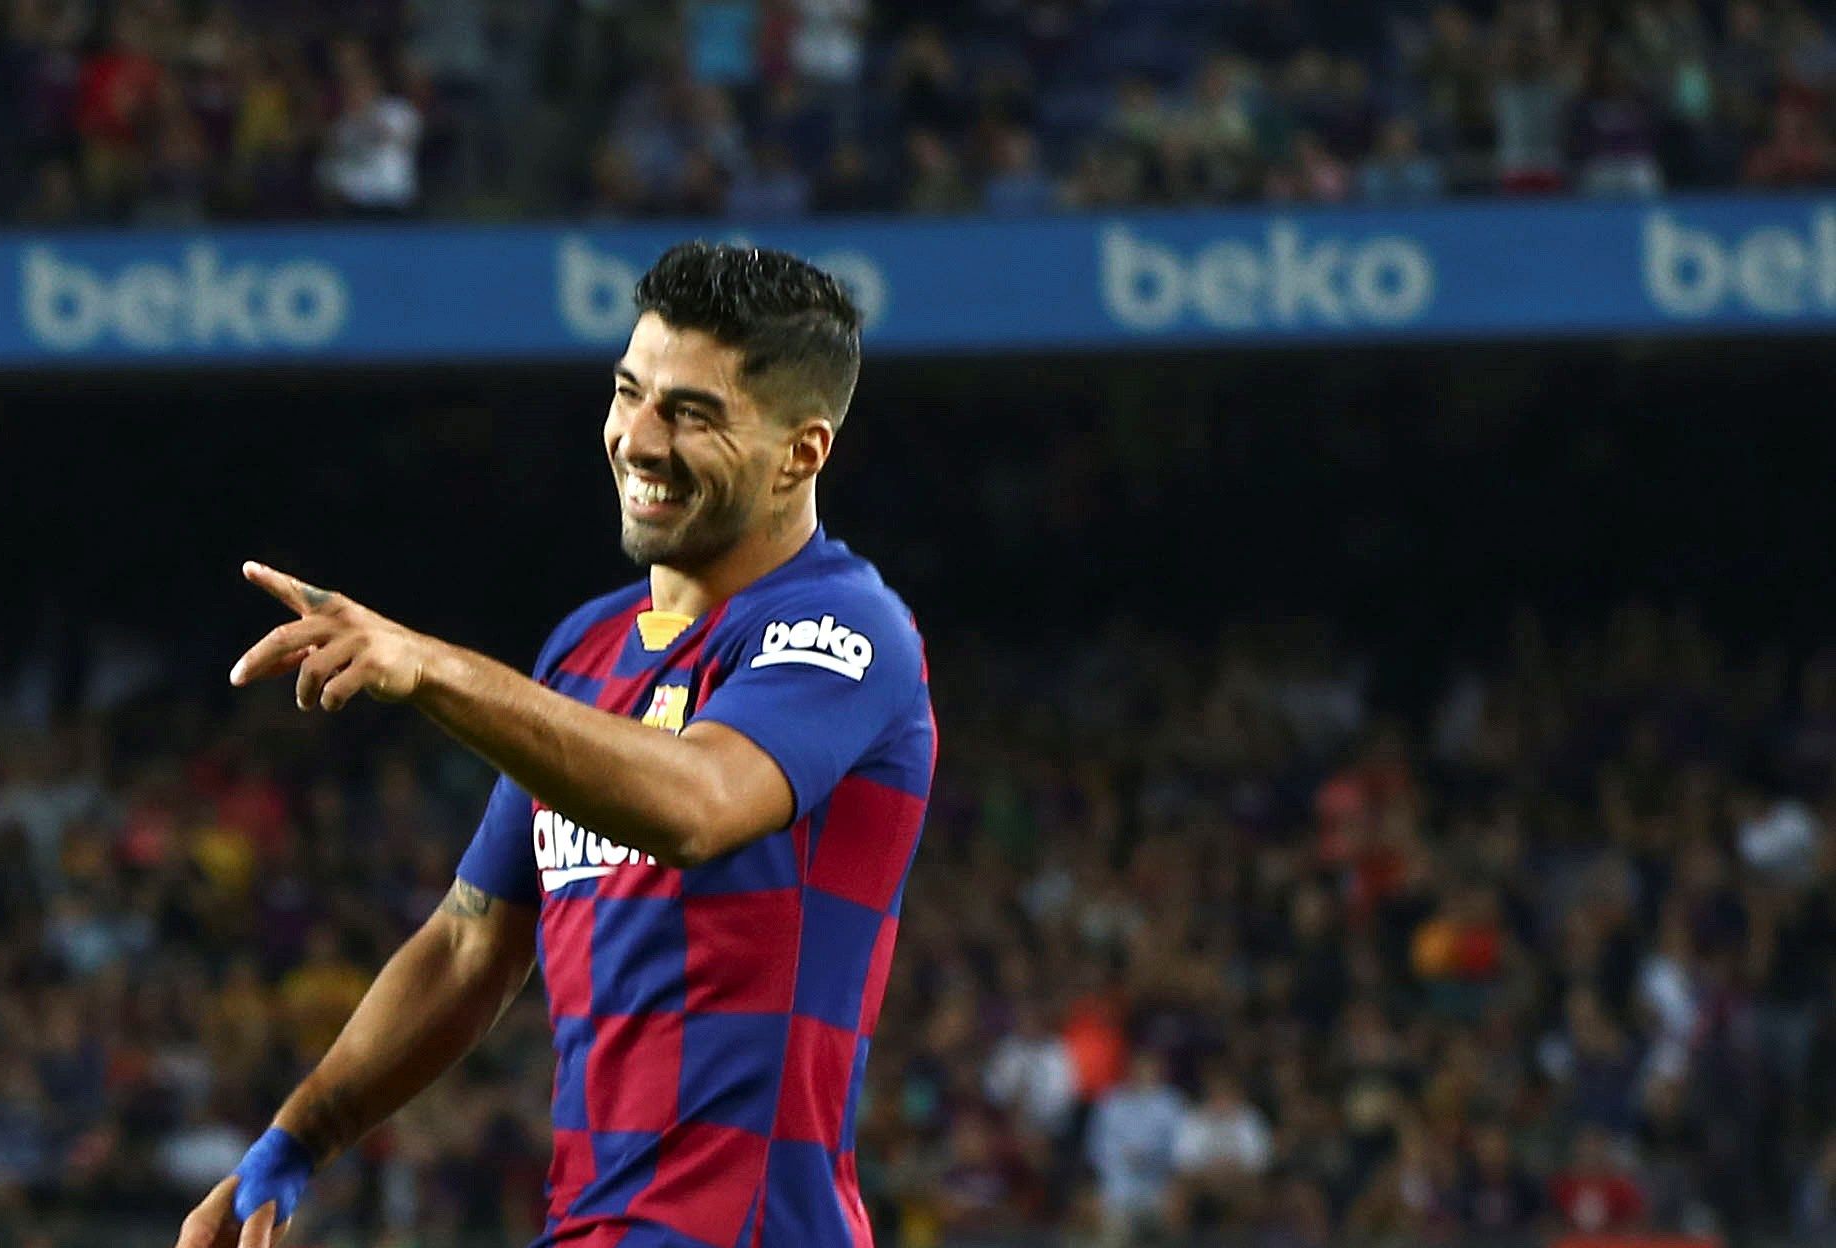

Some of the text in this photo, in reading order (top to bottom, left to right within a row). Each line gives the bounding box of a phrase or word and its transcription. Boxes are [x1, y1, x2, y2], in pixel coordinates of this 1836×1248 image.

[22, 243, 350, 350] beko
[1100, 220, 1434, 332] beko
[762, 614, 873, 668] beko
